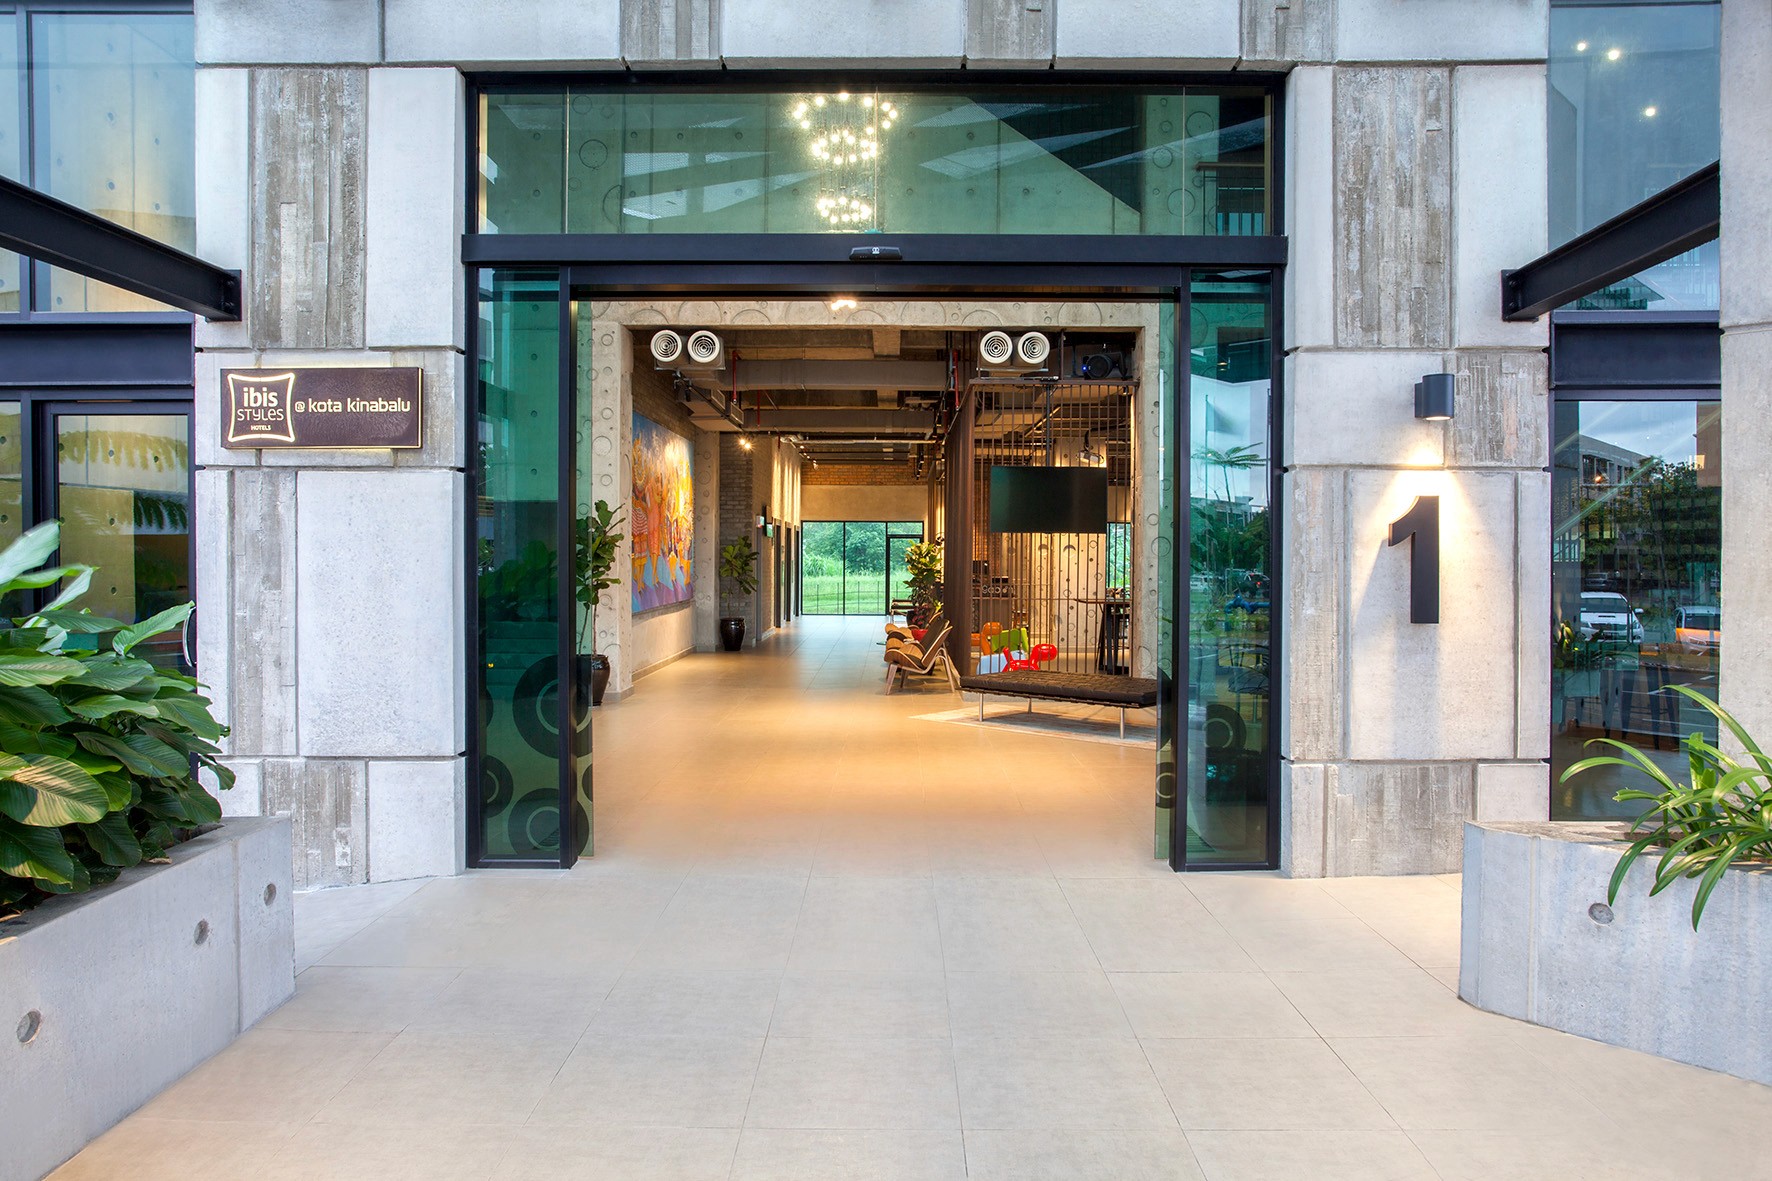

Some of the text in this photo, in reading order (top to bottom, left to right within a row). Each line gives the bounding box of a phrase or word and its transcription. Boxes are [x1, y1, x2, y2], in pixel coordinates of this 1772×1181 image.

[243, 387, 279, 407] ibis
[294, 397, 411, 413] @ kota kinabalu
[1388, 495, 1440, 624] 1
